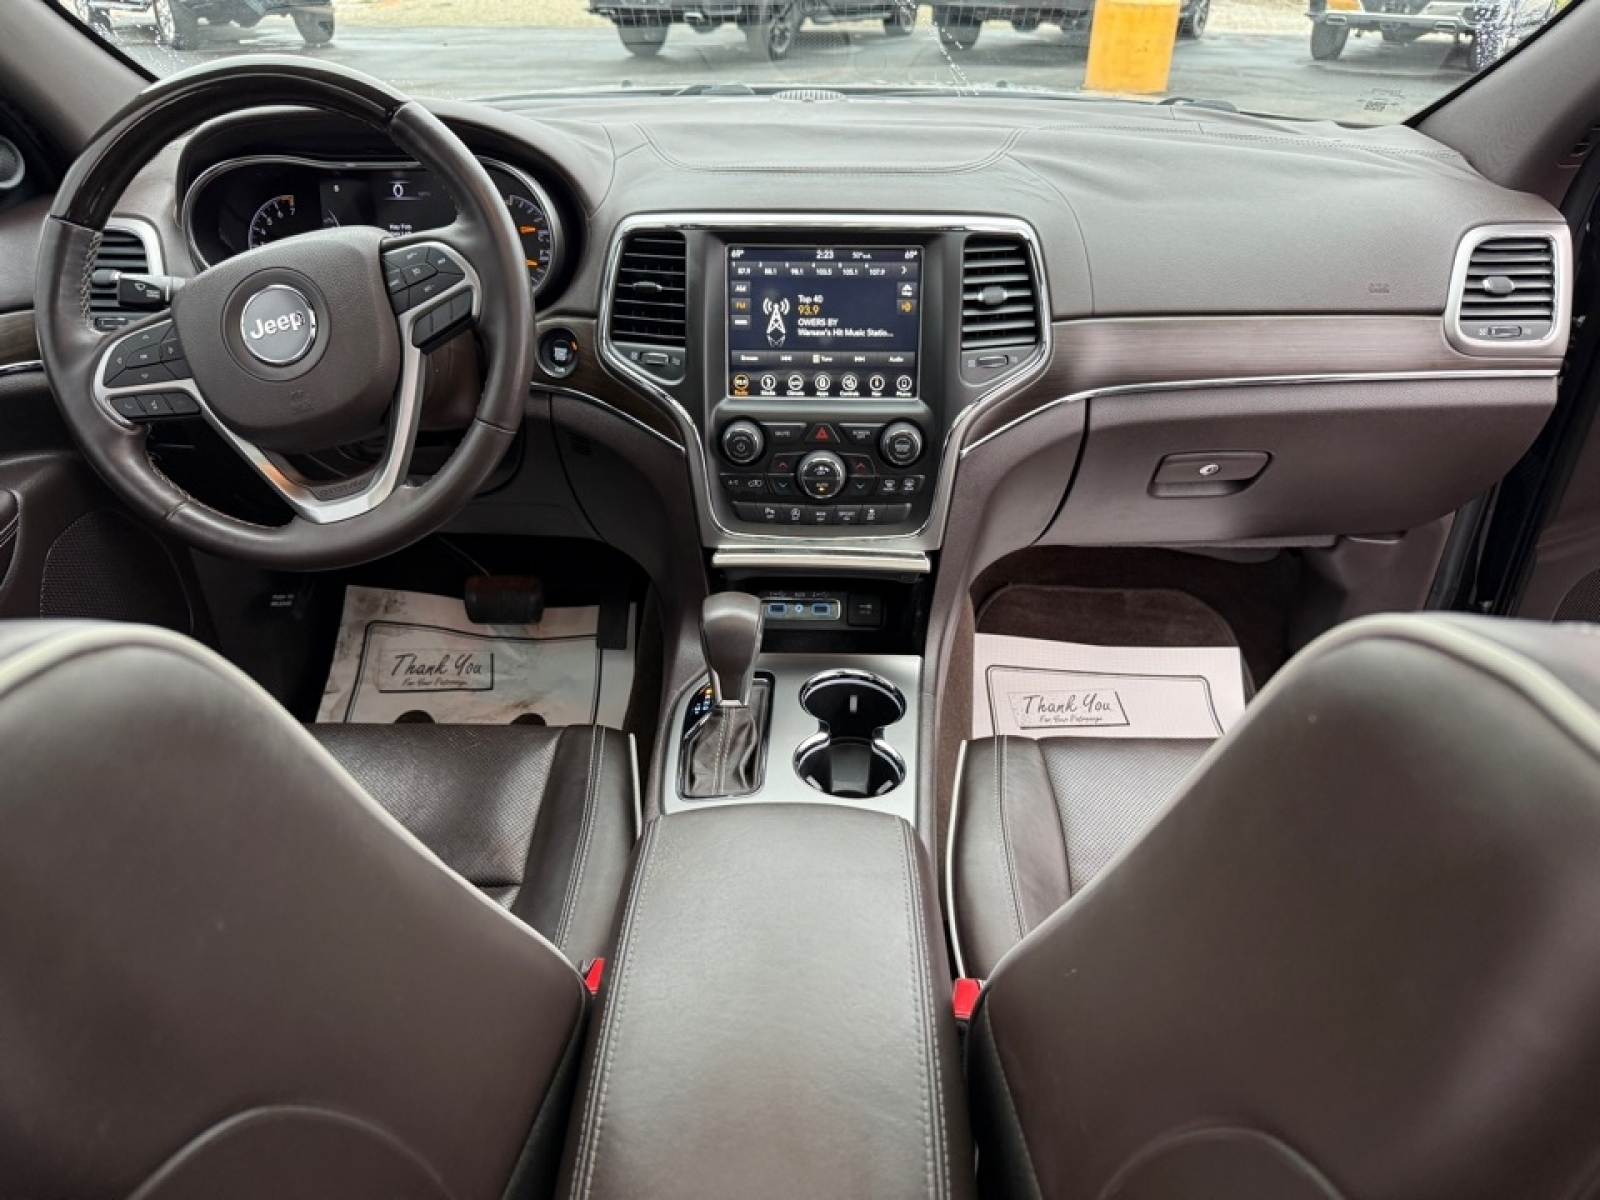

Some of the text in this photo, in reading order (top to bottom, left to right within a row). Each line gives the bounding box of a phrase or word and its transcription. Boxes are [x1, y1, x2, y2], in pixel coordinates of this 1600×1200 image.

[816, 249, 834, 259] 2:23
[798, 294, 824, 304] Top 40
[798, 304, 820, 315] 93.9
[250, 310, 306, 339] Jeep
[832, 328, 844, 337] Hit
[844, 328, 866, 337] Music
[391, 652, 482, 676] Thank You
[1022, 692, 1111, 714] Thank You
